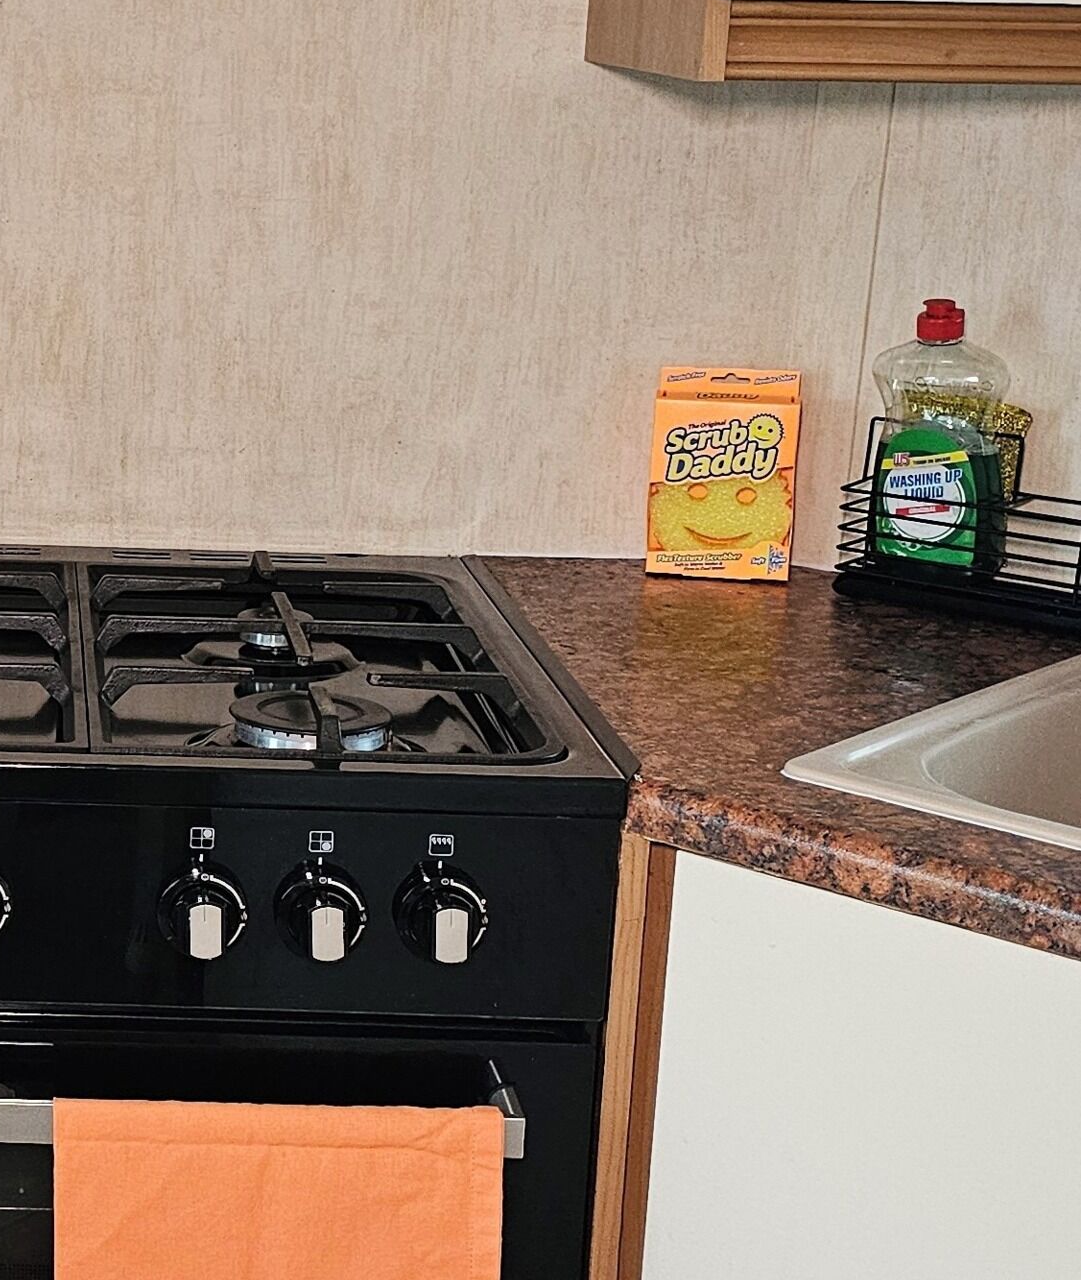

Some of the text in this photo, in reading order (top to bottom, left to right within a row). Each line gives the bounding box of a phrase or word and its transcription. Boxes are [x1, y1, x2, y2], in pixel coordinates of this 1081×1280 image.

[700, 420, 726, 429] Original
[665, 419, 749, 454] Scrub
[665, 440, 779, 482] Daddy
[889, 469, 962, 488] WASHING UP
[704, 552, 743, 562] Scrubber
